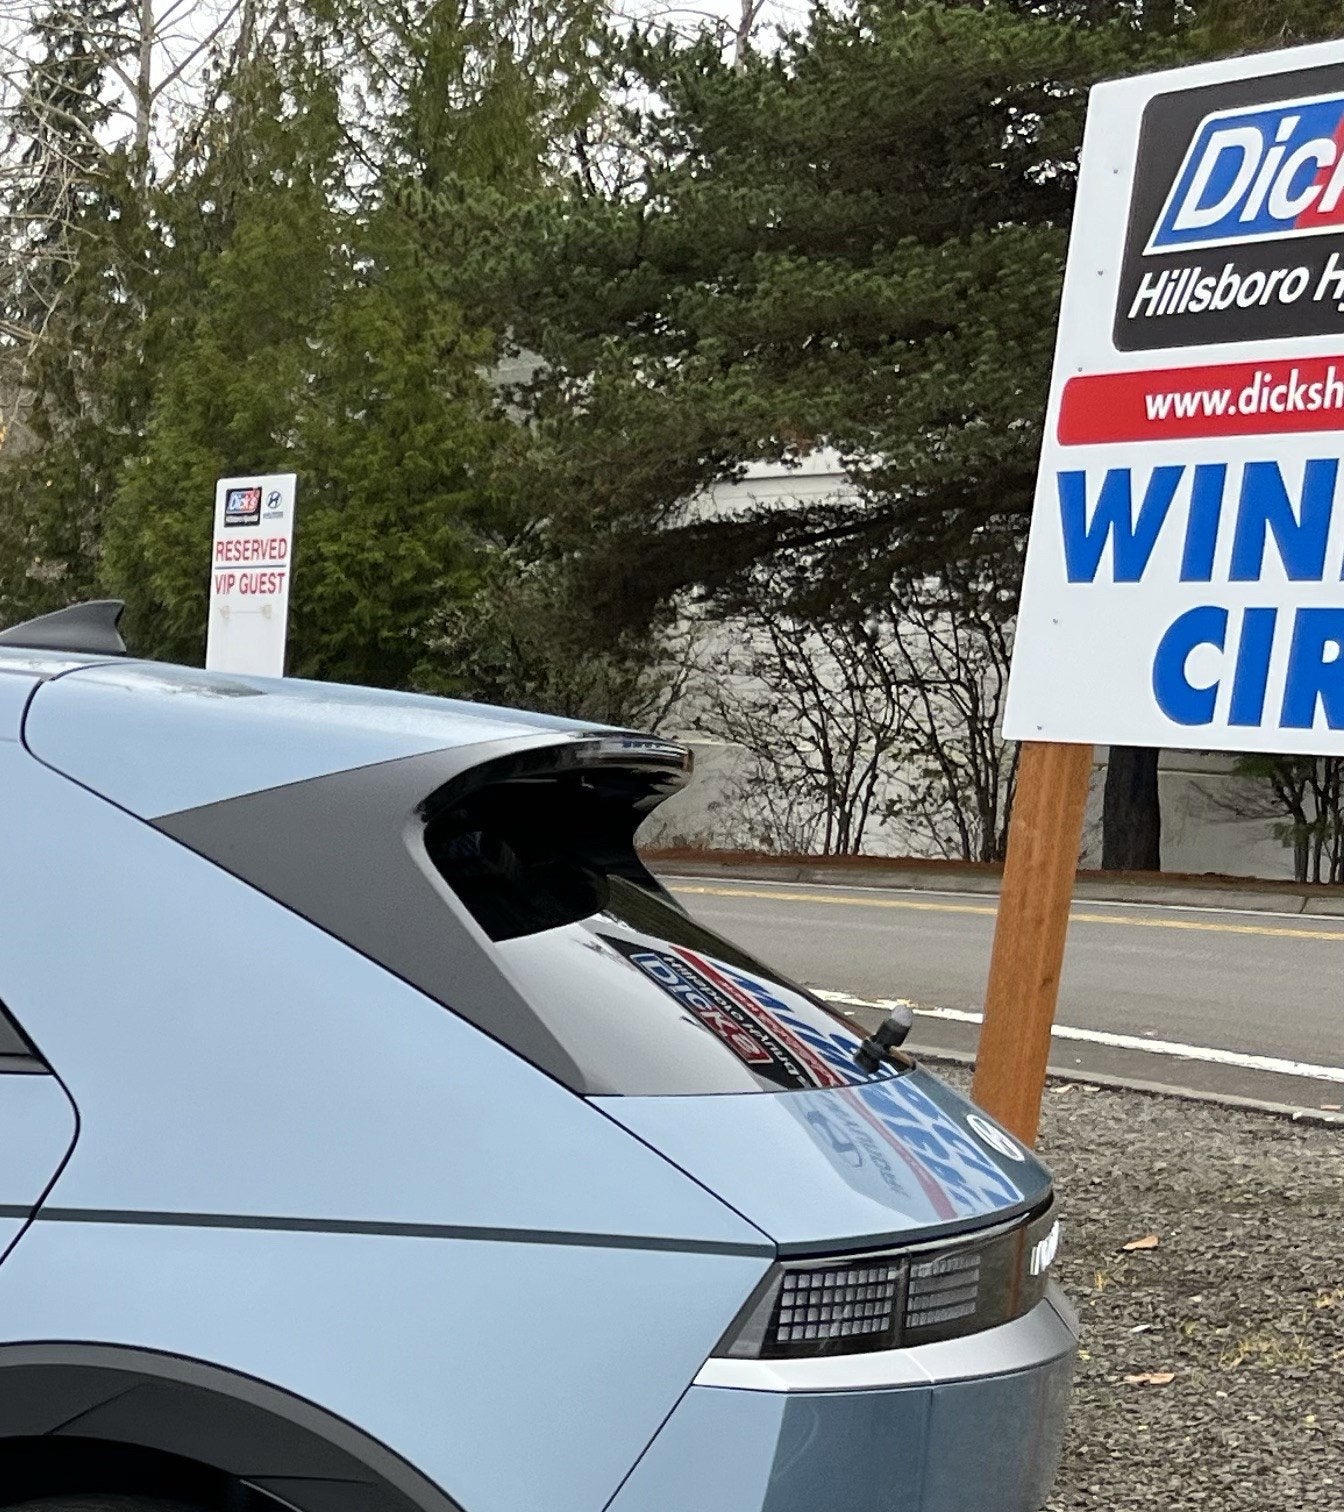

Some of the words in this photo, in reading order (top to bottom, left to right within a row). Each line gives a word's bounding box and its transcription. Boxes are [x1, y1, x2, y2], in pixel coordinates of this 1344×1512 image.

[1127, 262, 1310, 319] Hillsboro
[1313, 252, 1344, 312] H
[1144, 365, 1344, 420] www.dicksh
[1056, 457, 1344, 585] WIN
[215, 538, 288, 562] RESERVED
[215, 574, 235, 595] VIP
[239, 572, 286, 595] GUEST
